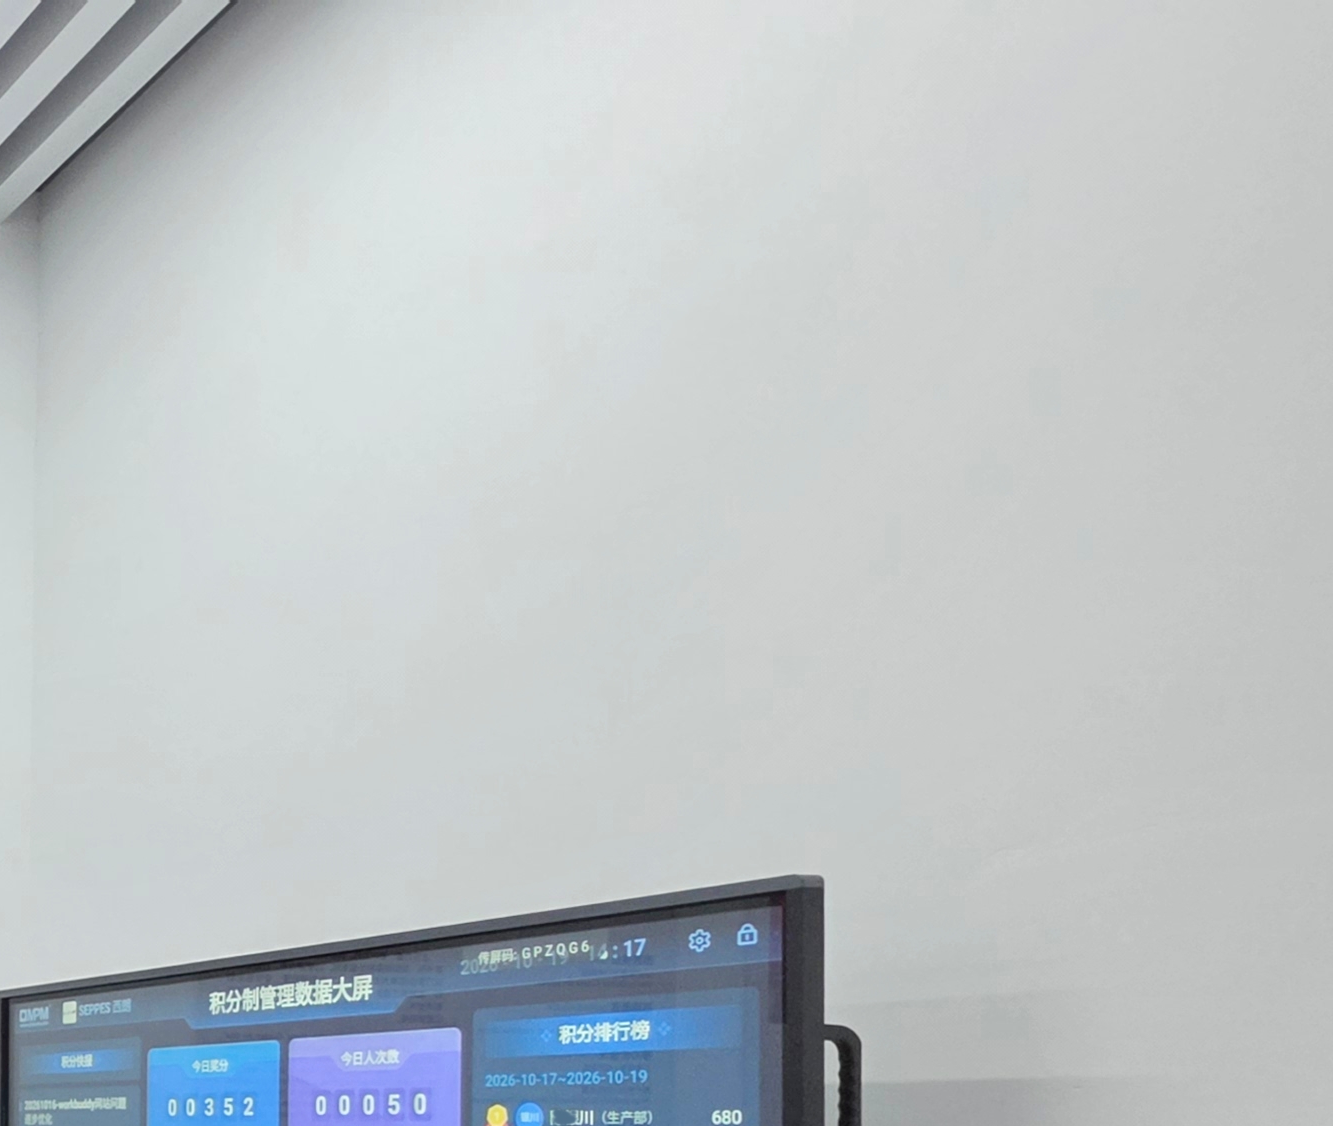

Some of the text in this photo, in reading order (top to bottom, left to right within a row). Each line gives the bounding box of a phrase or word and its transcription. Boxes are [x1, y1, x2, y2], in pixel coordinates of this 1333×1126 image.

[522, 940, 589, 959] GPZQG6
[209, 975, 373, 1014] 积分制管理数据大屏
[79, 1002, 111, 1016] SEPPES
[559, 1021, 650, 1044] 积分排行榜
[192, 1059, 229, 1073] 今日奖分
[341, 1049, 401, 1067] 今日人次数
[485, 1070, 648, 1087] 2026-10-17~2026-10-19
[711, 1109, 743, 1126] 680
